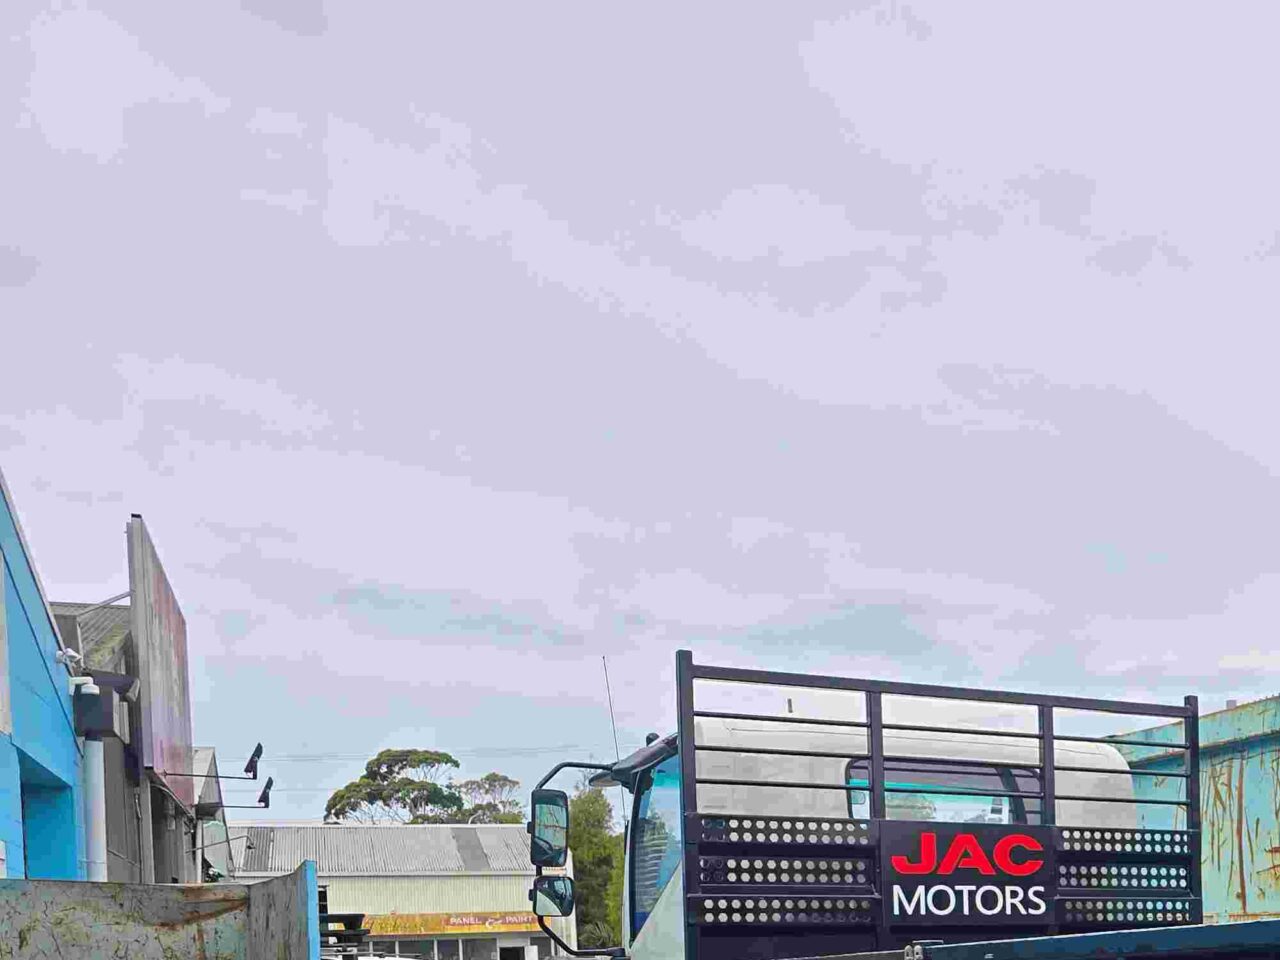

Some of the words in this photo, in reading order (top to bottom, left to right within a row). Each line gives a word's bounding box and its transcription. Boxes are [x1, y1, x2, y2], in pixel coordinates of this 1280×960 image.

[890, 831, 1045, 877] JAC
[892, 884, 1047, 916] MOTORS
[450, 916, 481, 926] PANEL
